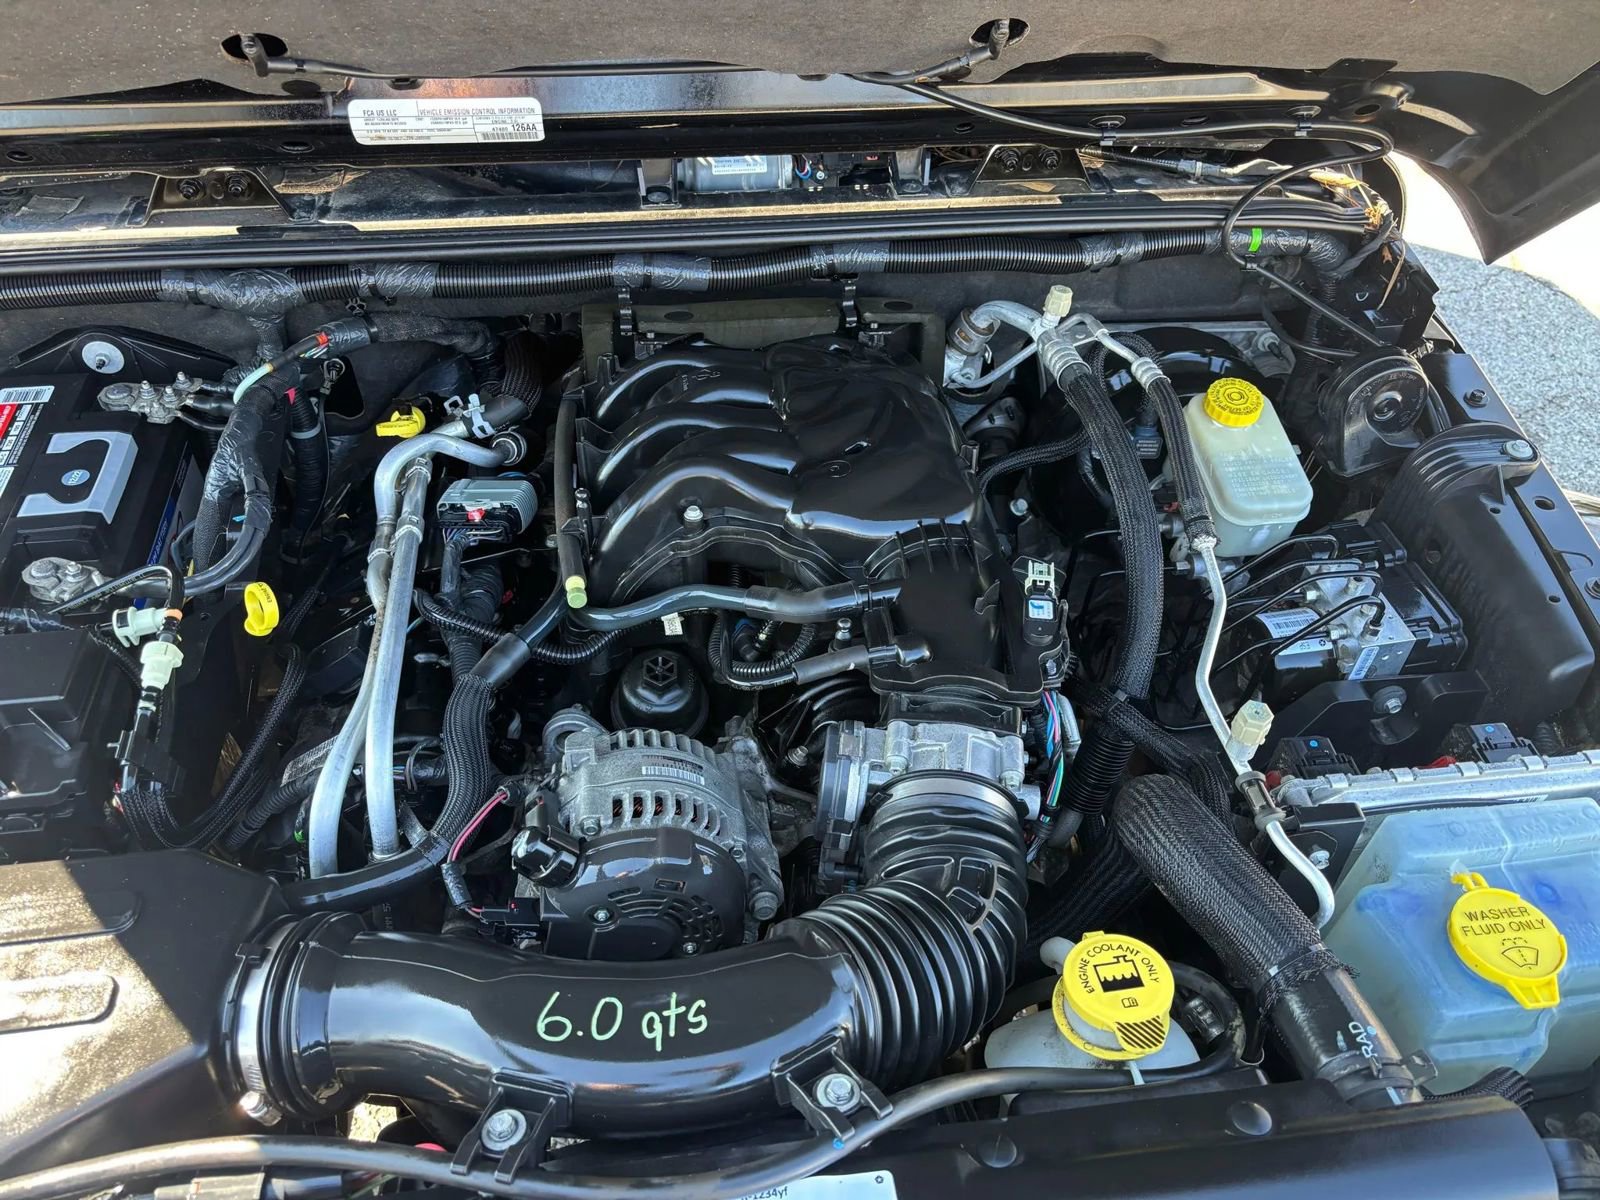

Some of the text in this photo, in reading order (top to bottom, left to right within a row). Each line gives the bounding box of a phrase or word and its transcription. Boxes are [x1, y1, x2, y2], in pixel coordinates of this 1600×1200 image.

[362, 109, 397, 117] FCA US LLC
[419, 107, 536, 117] VEHICLE EMISSION CONTROL INFORMATION
[511, 123, 538, 132] 126AA
[1464, 906, 1530, 922] WASHER
[1461, 918, 1547, 937] FLUID ONLY
[1080, 942, 1161, 995] ENGINE COOLANT ONLY
[536, 991, 708, 1052] 6.0 qts
[1348, 1021, 1378, 1059] RAD
